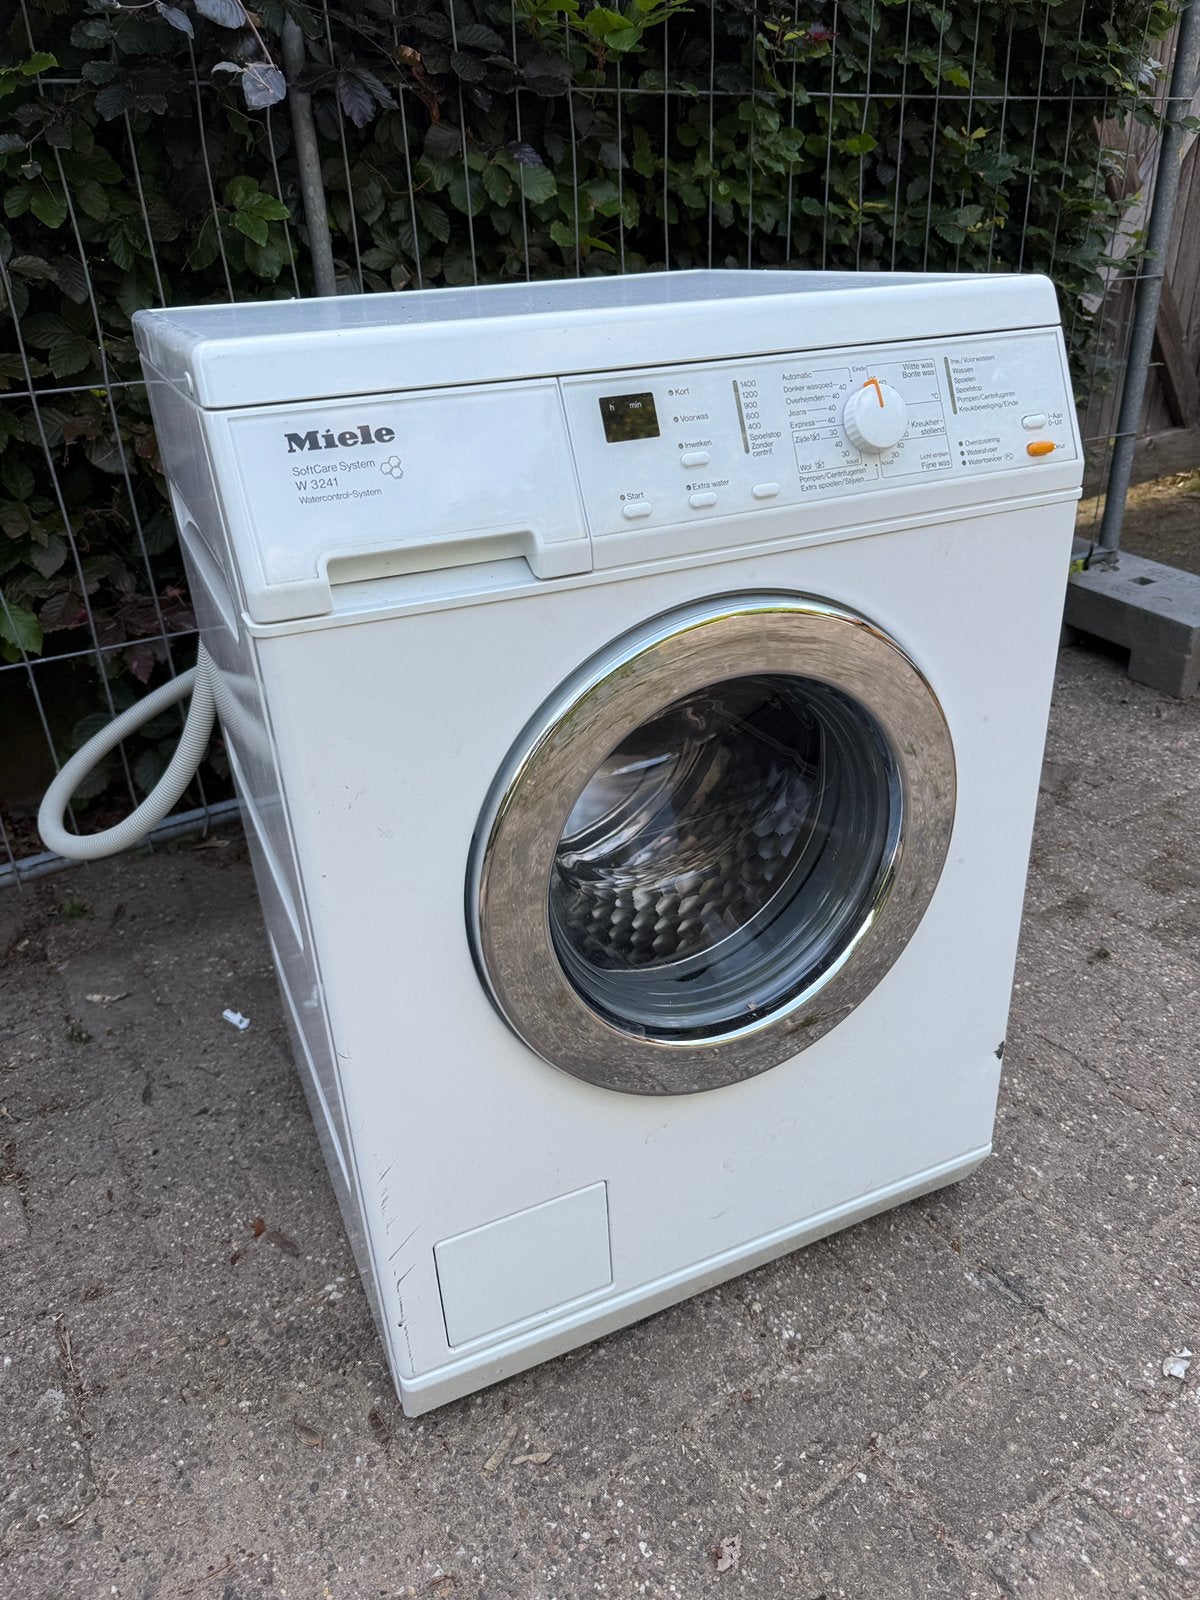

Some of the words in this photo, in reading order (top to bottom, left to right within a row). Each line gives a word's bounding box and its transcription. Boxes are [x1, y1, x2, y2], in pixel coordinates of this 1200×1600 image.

[902, 363, 920, 371] Witte
[782, 372, 812, 380] Automatic
[902, 370, 921, 378] Bonte
[954, 376, 976, 384] Spoelen
[675, 387, 690, 395] Kort
[783, 384, 805, 393] Donker
[806, 381, 833, 390] wasgoed
[956, 385, 982, 393] Spoelstop
[786, 395, 825, 405] Overhemden
[609, 403, 615, 411] h
[744, 401, 757, 409] 900
[680, 413, 709, 422] Voorwas
[788, 409, 807, 417] Jeans
[790, 420, 815, 429] Express
[921, 427, 945, 435] stellend
[284, 425, 395, 453] Miele
[750, 431, 781, 441] Spoelstop
[684, 440, 712, 449] Inweken
[752, 441, 774, 449] Zonder
[965, 437, 1000, 447] Overdosering
[292, 463, 338, 476] SoftCare
[339, 459, 375, 472] System
[921, 461, 937, 469] Fijne
[799, 468, 866, 482] Pompen/Centrifugeren
[295, 481, 307, 491] W
[311, 477, 338, 490] 3241
[693, 482, 711, 491] Extra
[711, 479, 730, 488] water
[800, 483, 817, 492] Extra
[299, 487, 382, 504] Watercontrol-System
[627, 491, 644, 500] Start
